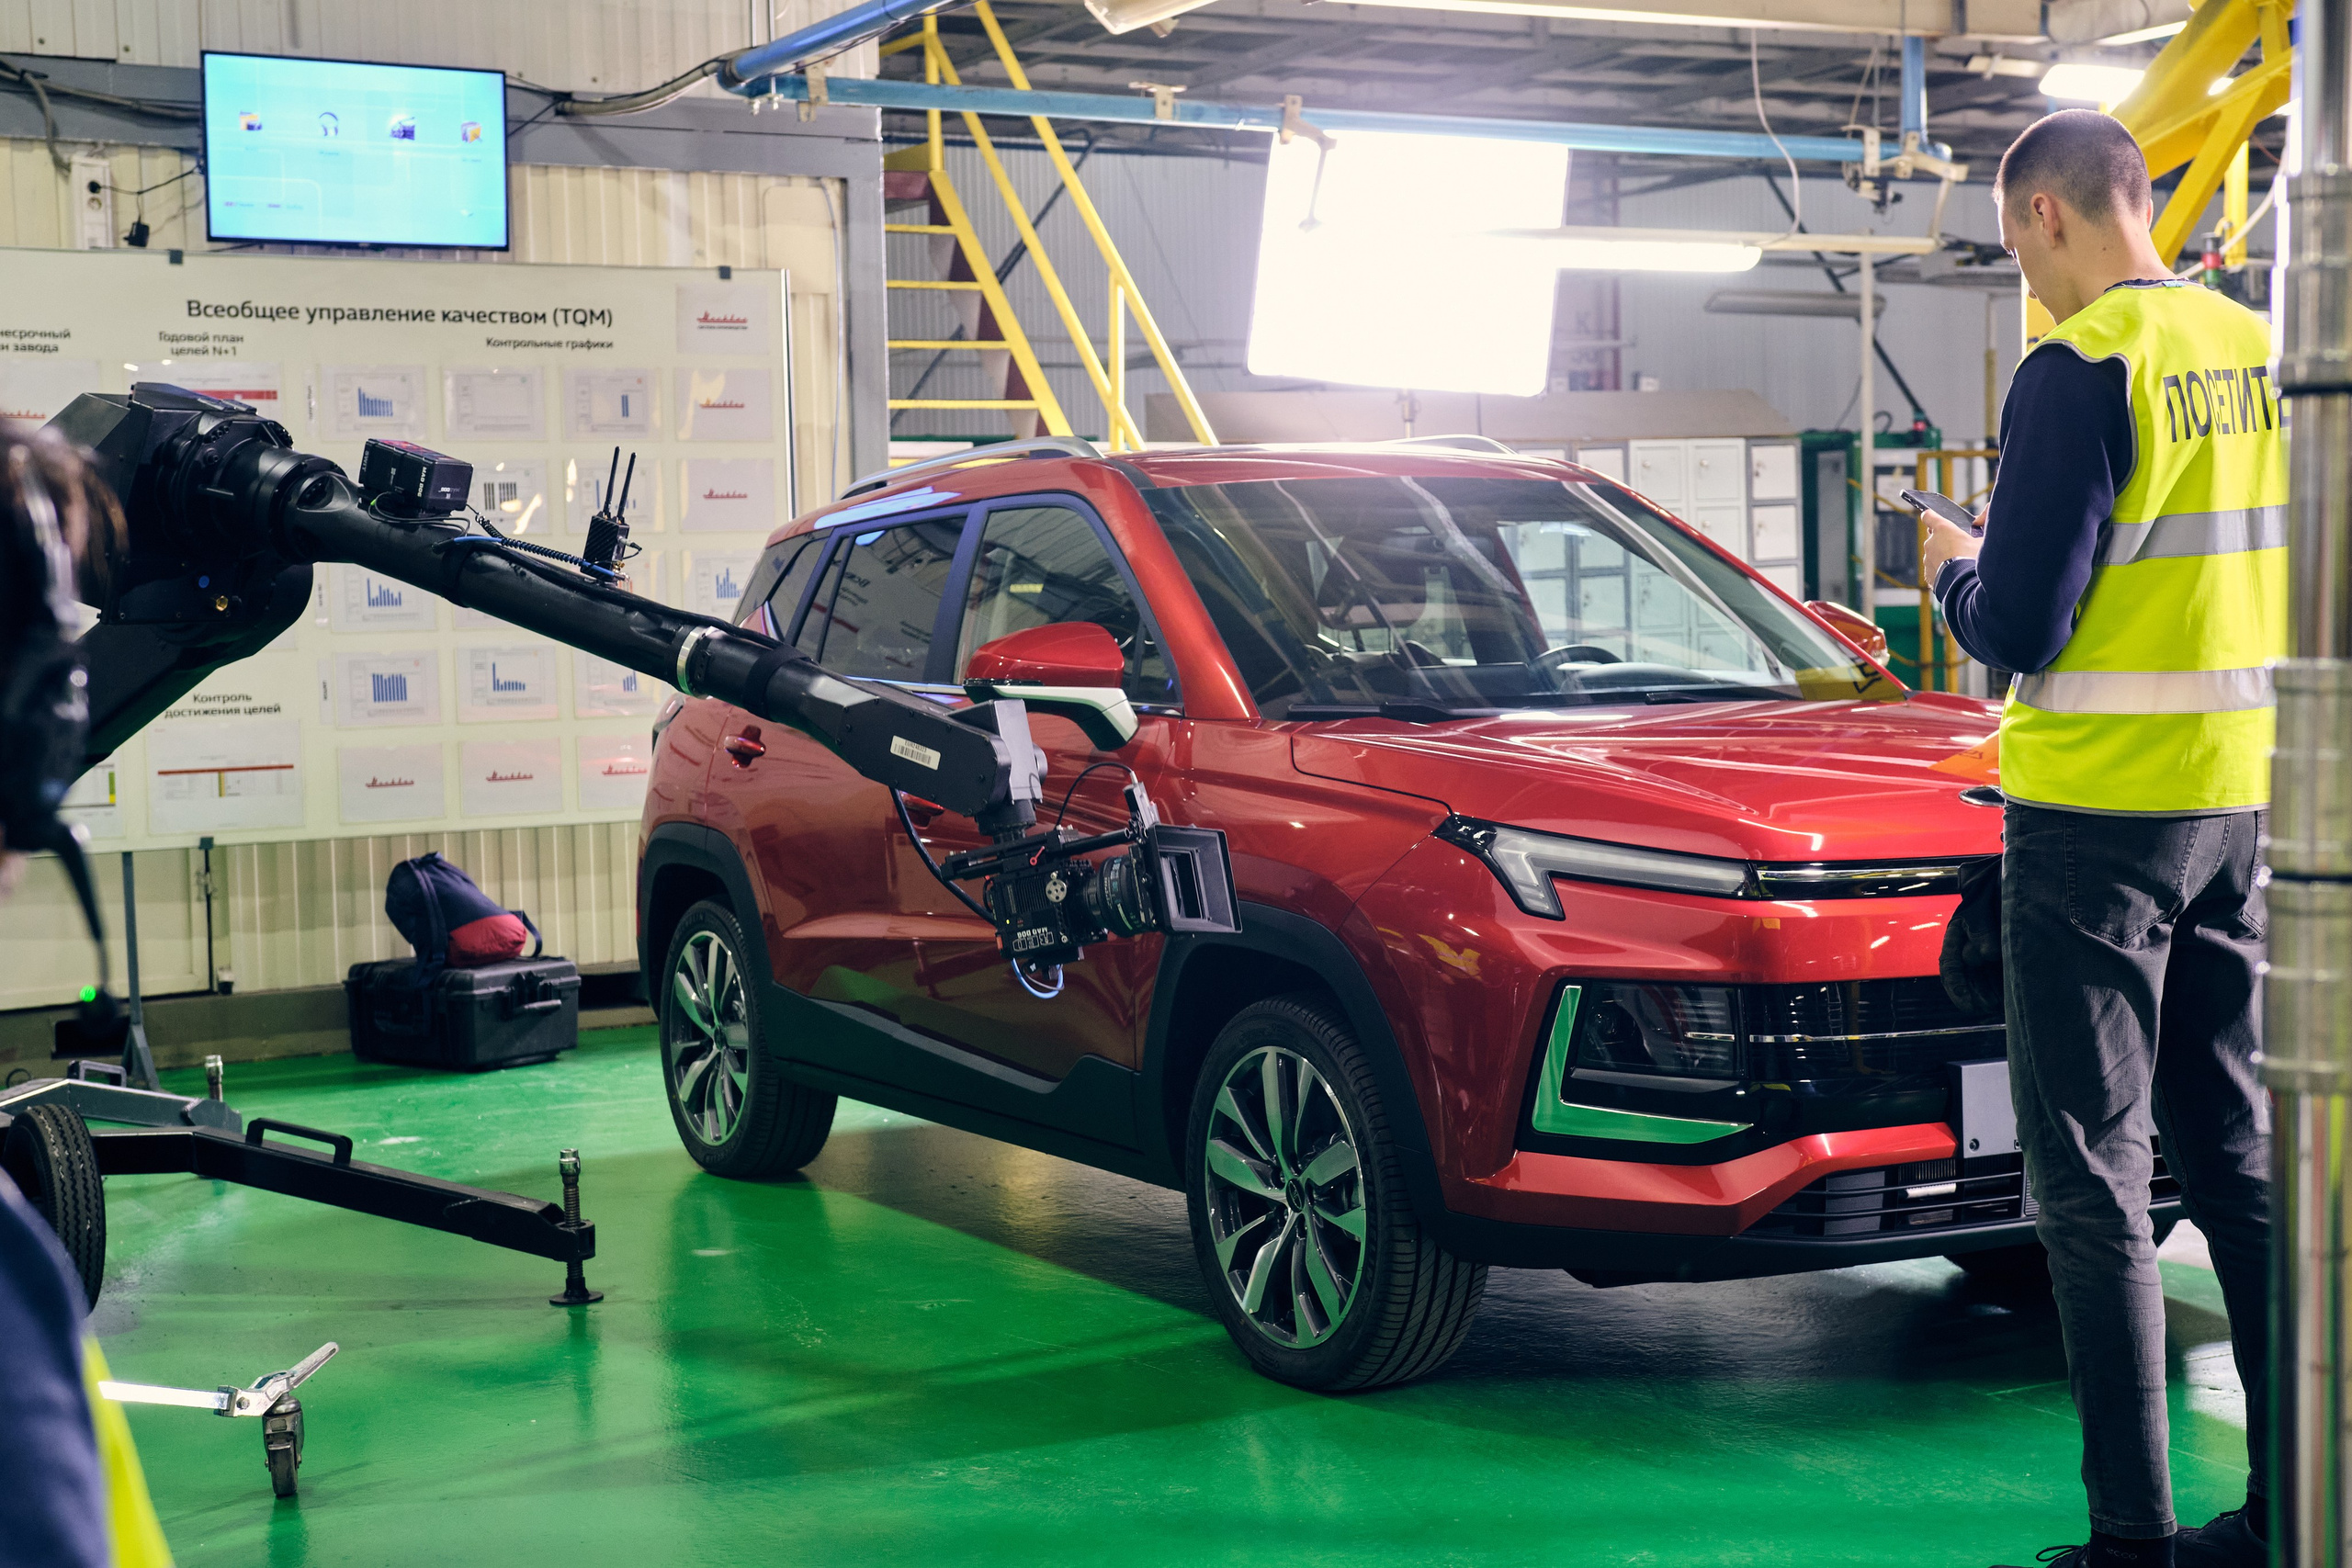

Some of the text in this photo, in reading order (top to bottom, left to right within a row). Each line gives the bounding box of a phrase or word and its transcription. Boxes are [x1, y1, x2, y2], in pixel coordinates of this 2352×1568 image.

[187, 299, 613, 328] Всеобщее управление качеством (TQM)
[159, 331, 244, 344] Годовой план
[14, 344, 59, 354] завода
[486, 337, 614, 351] Контрольные графики
[171, 345, 209, 356] целей
[193, 693, 253, 704] Контроль
[164, 703, 281, 718] достижения целей
[2106, 1548, 2138, 1559] ecco
